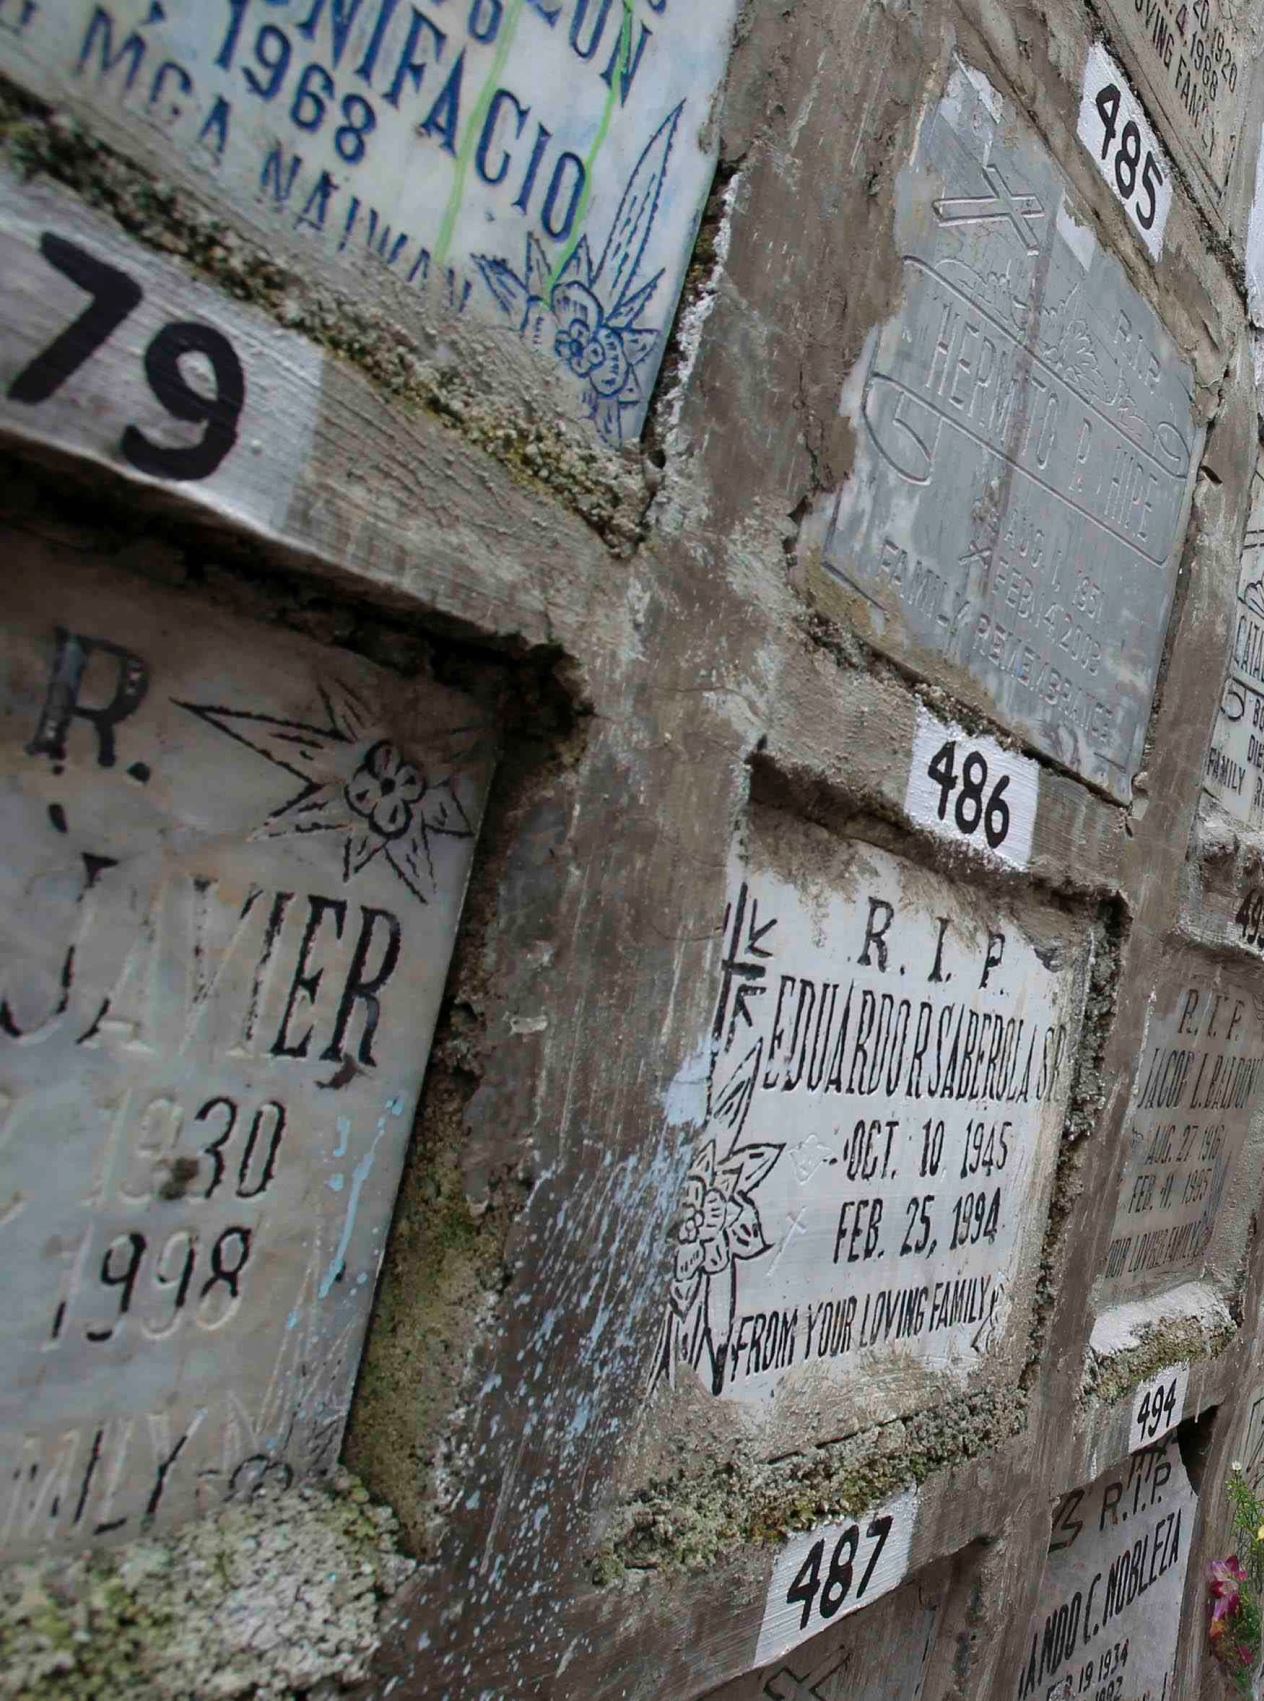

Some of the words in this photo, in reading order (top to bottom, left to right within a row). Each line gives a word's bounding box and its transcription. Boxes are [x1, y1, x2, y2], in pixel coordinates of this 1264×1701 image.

[1096, 83, 1164, 231] 485
[6, 230, 246, 481] 79
[927, 740, 1011, 850] 486
[1205, 747, 1246, 797] FAMILY
[921, 1119, 945, 1180] 10
[959, 1120, 1013, 1181] 1945
[833, 1199, 886, 1265] FEB.
[951, 1187, 1003, 1251] 1994
[732, 1308, 799, 1382] FROM
[804, 1301, 854, 1360] YOUR
[859, 1288, 926, 1348] LOVING
[929, 1272, 993, 1338] FAMILY
[1136, 1377, 1178, 1442] 494
[786, 1516, 894, 1631] 487
